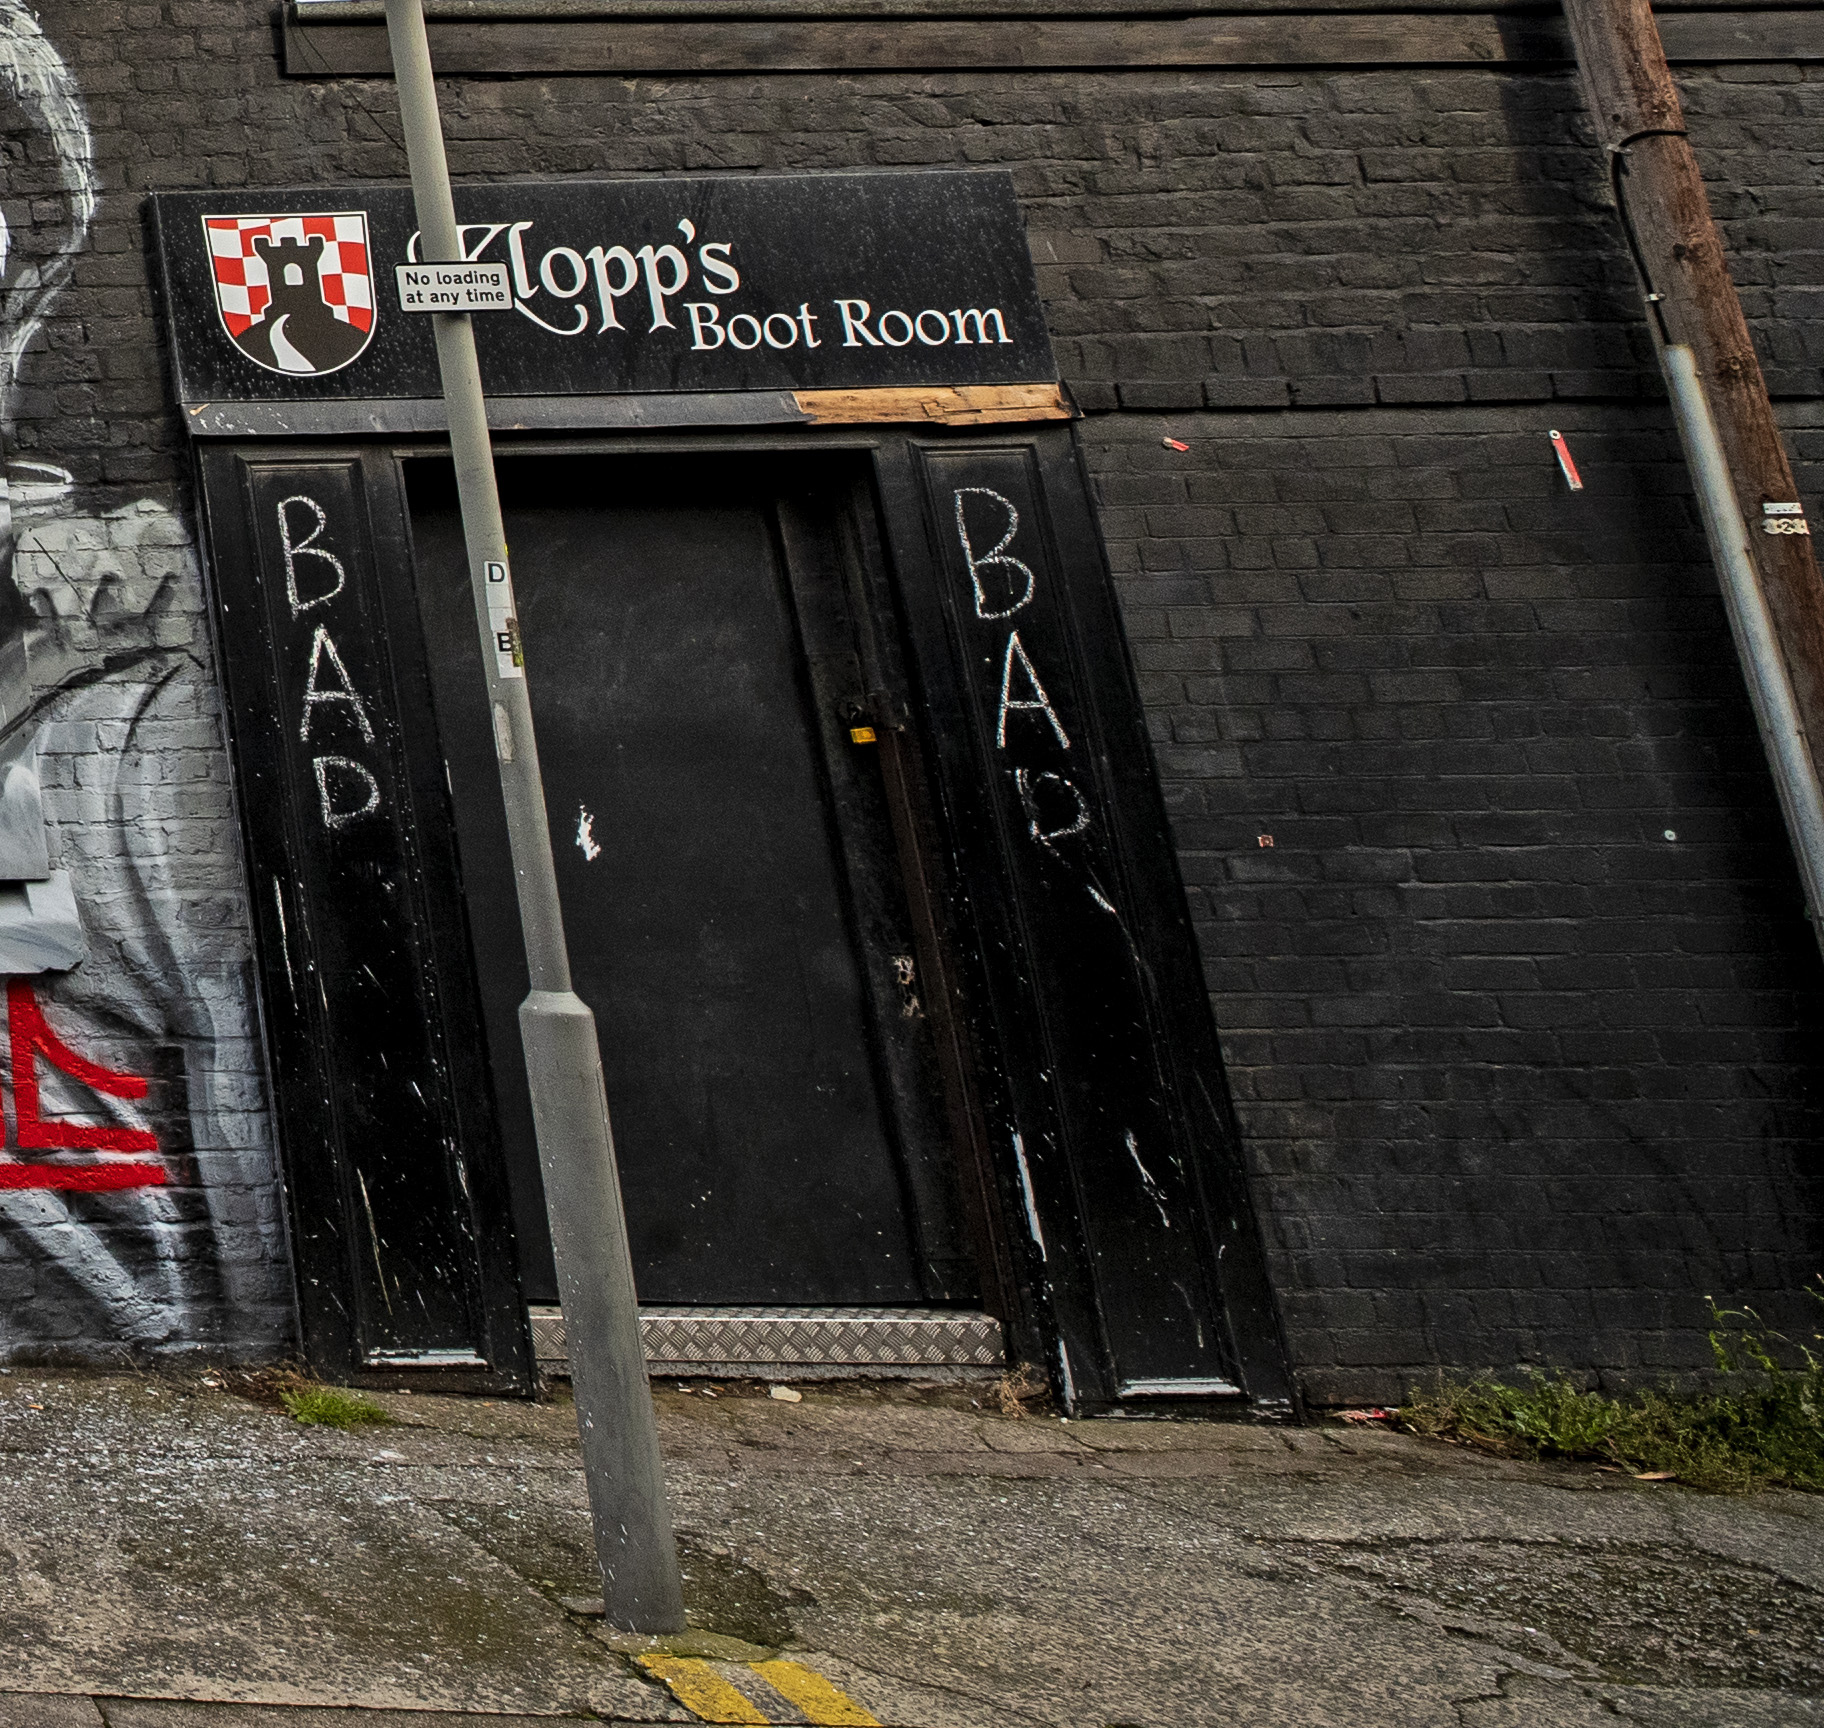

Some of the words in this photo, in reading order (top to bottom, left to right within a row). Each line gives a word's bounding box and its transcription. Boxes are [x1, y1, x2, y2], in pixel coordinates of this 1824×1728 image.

[405, 271, 431, 286] No
[436, 270, 501, 286] loading
[405, 290, 425, 304] at
[429, 290, 460, 307] any
[465, 289, 506, 304] time
[682, 301, 822, 351] Boot
[834, 298, 1015, 347] Room
[487, 562, 506, 583] D
